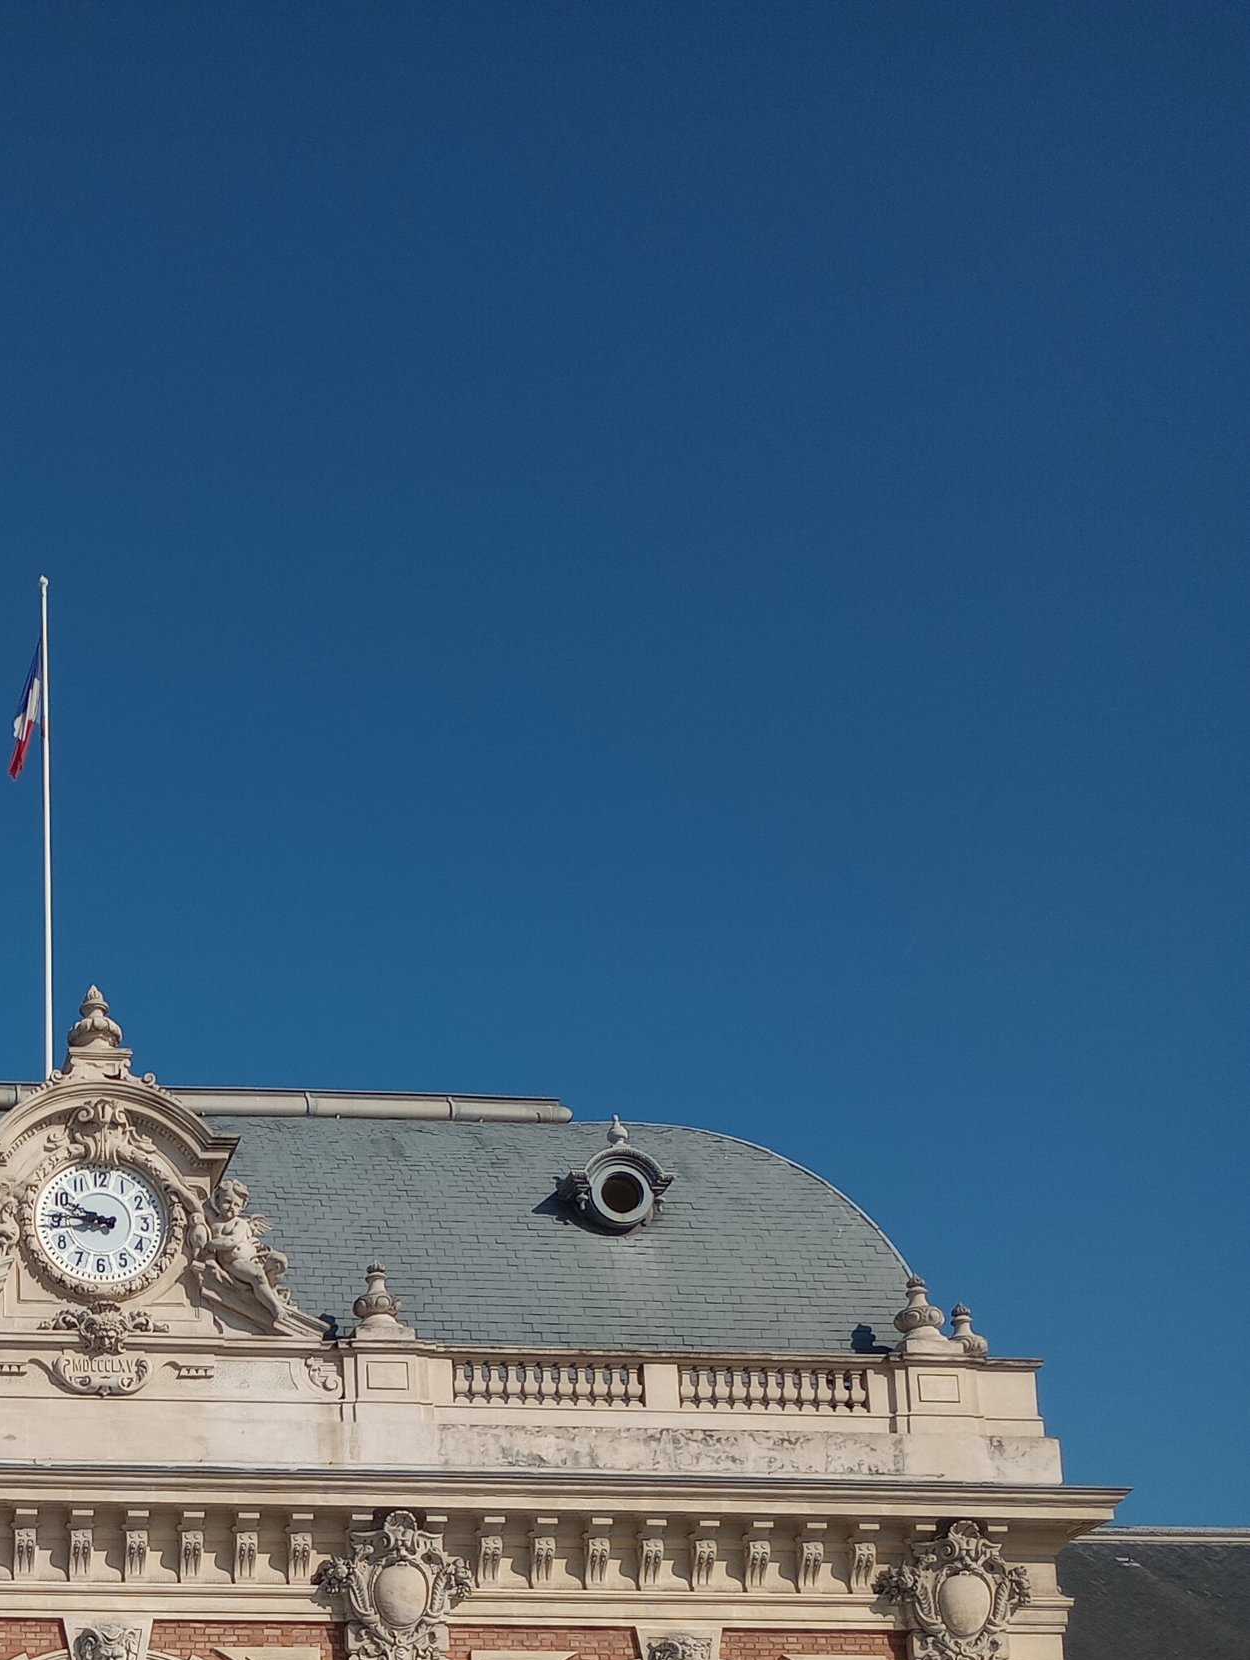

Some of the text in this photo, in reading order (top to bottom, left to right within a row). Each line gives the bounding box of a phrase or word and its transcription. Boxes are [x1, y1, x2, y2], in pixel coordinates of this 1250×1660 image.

[73, 1177, 83, 1192] 11
[93, 1172, 107, 1188] 12
[120, 1179, 124, 1194] 1
[54, 1192, 68, 1207] 10
[134, 1195, 144, 1210] 2
[51, 1213, 61, 1229] 9
[140, 1217, 149, 1232] 3
[57, 1235, 67, 1249] 8
[134, 1237, 144, 1253] 4
[74, 1251, 84, 1266] 7
[96, 1258, 106, 1273] 6
[118, 1253, 128, 1268] 5
[72, 1358, 134, 1373] MDCCCLXV
